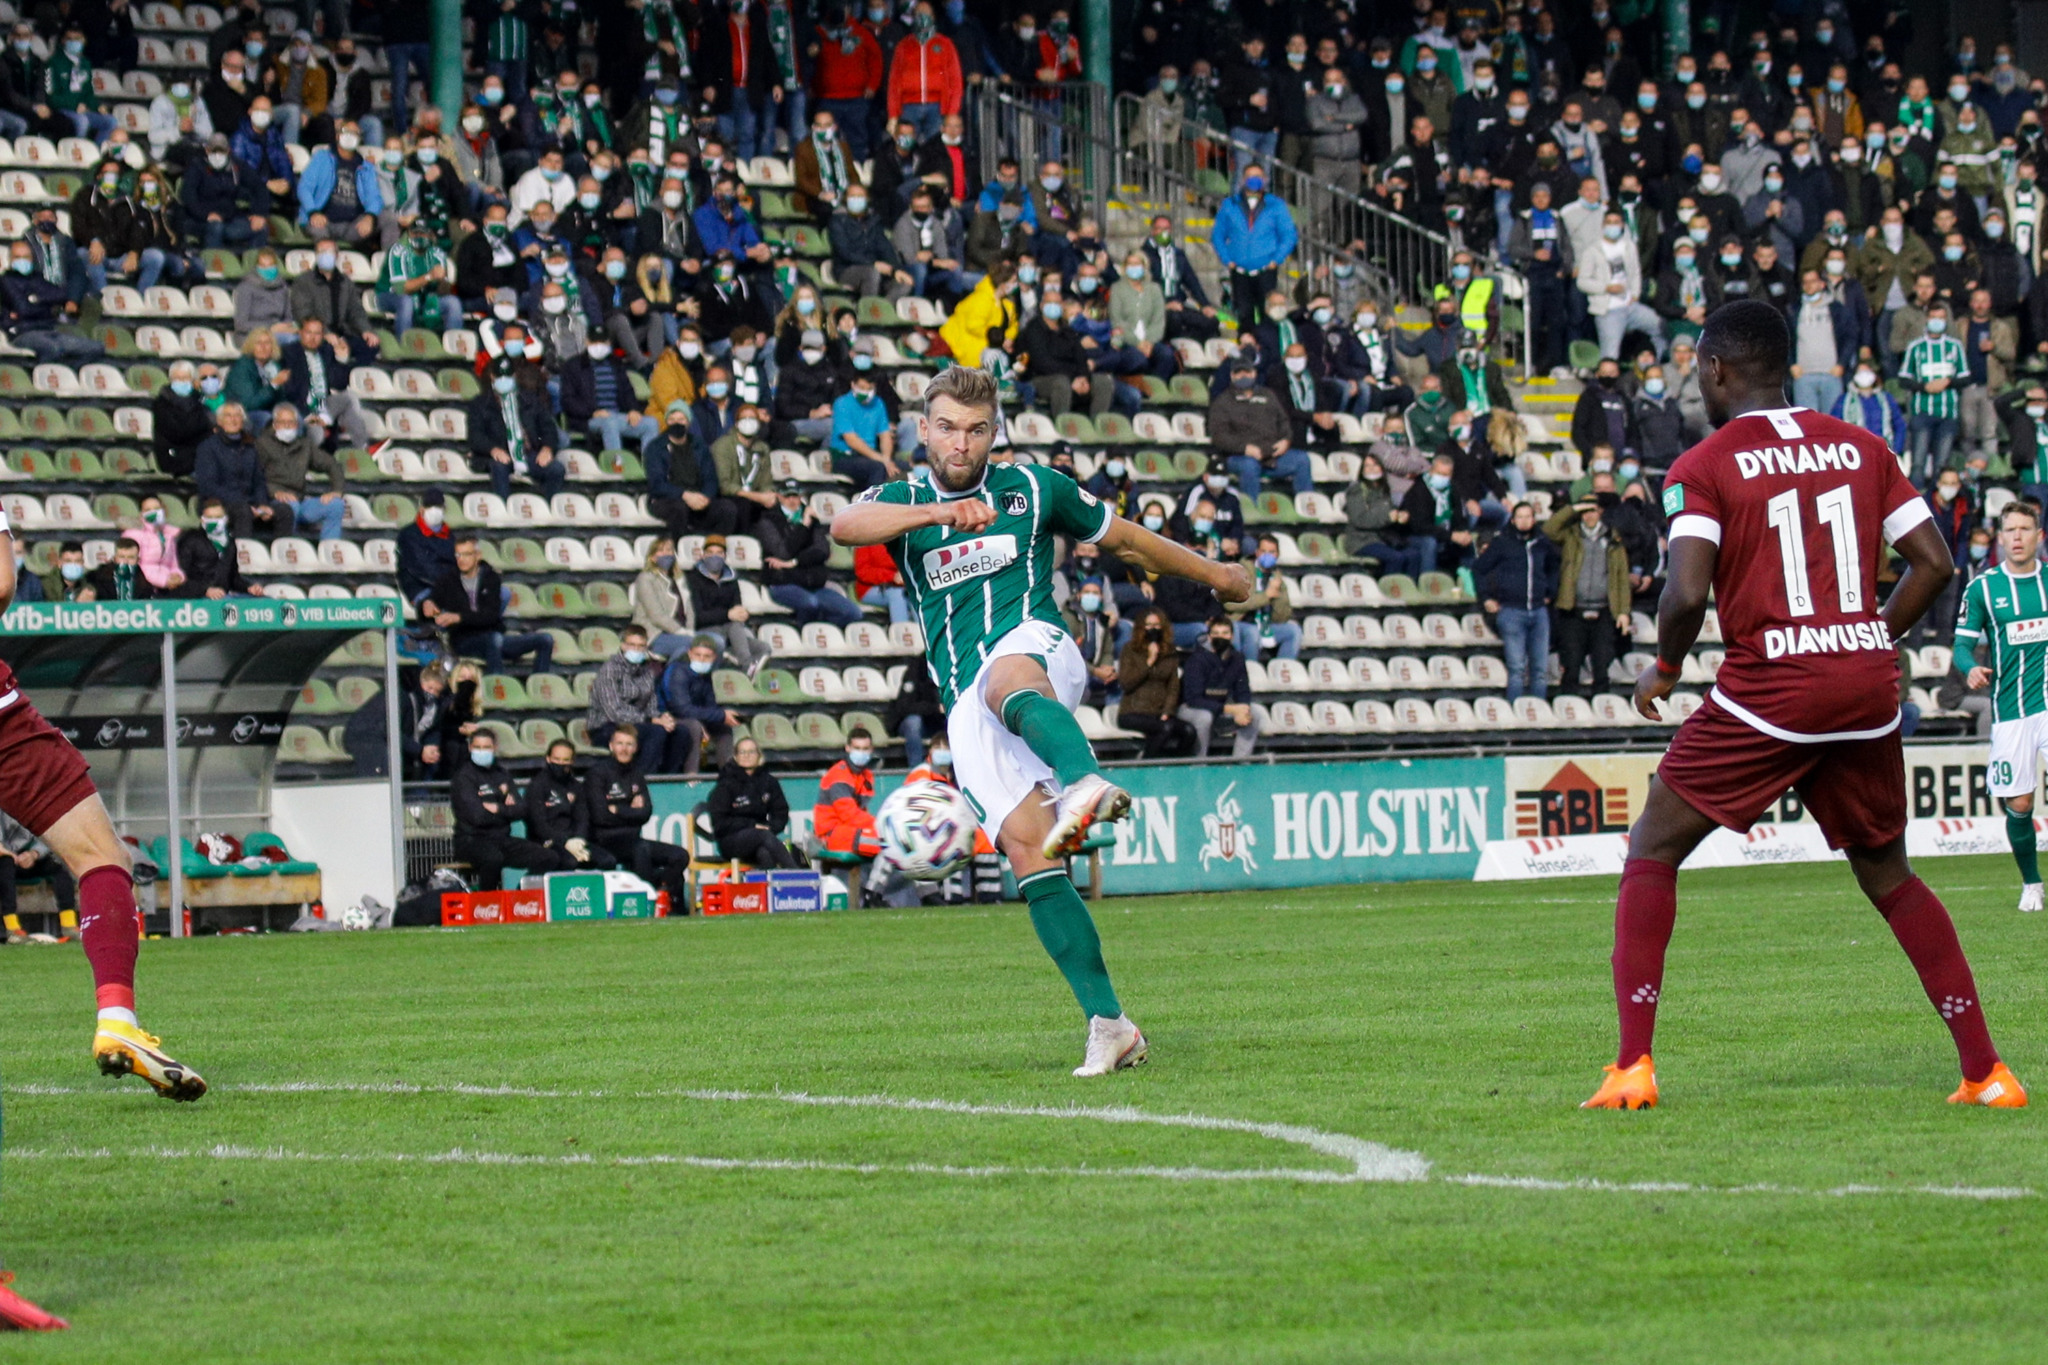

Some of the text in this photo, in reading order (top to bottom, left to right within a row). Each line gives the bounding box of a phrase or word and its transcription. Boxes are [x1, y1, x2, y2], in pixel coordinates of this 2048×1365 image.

[1734, 443, 1861, 480] DYNAMO
[1768, 484, 1863, 617] 11
[244, 608, 274, 622] 1919
[301, 607, 375, 621] VfB Lübeck
[1764, 621, 1894, 660] DIAWUSIE
[2009, 628, 2048, 643] HanseB
[1992, 761, 2013, 786] 39
[1913, 765, 2006, 818] BER
[1271, 787, 1490, 861] HOLSTEN
[1740, 843, 1807, 861] HanseBelt
[1524, 854, 1599, 874] HanseBelt
[565, 886, 590, 901] AOK
[566, 906, 592, 917] PLUS
[775, 896, 816, 912] Leukotape
